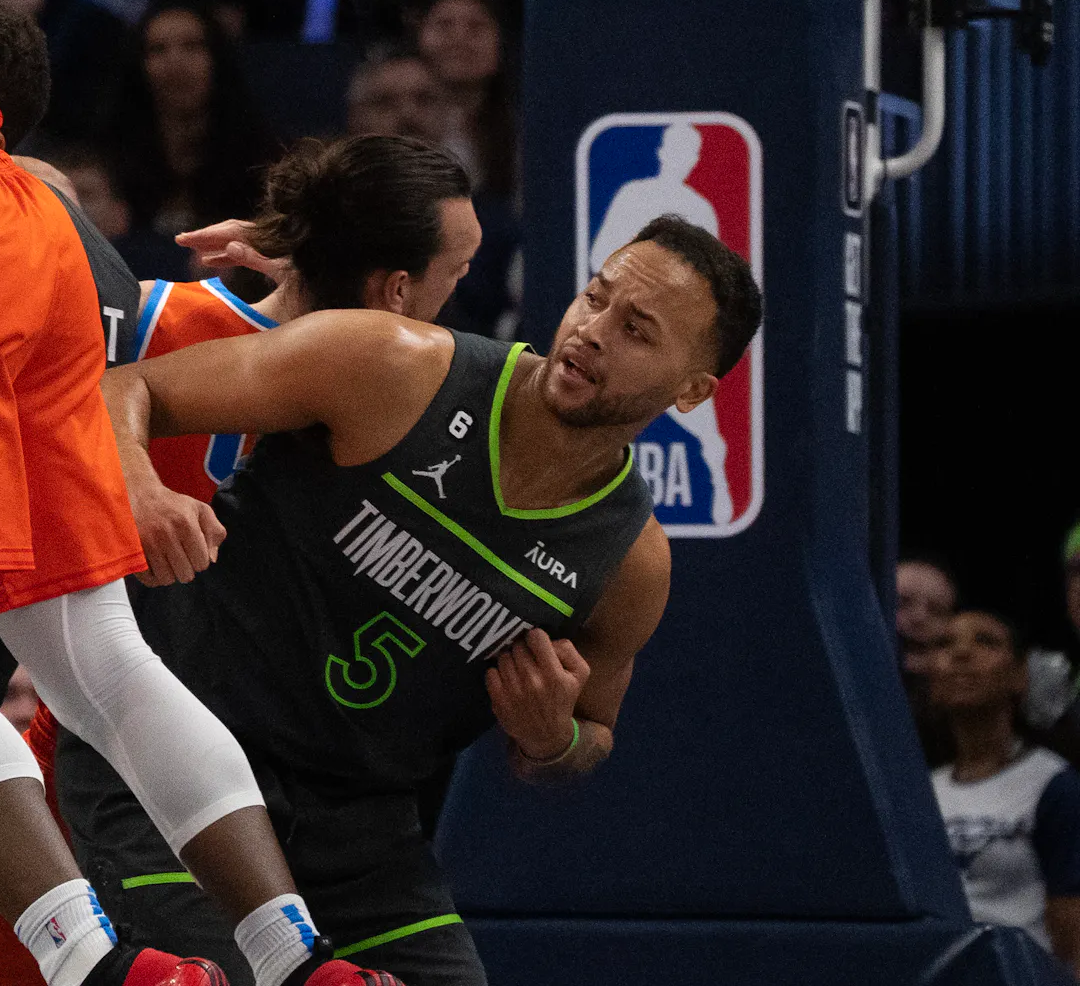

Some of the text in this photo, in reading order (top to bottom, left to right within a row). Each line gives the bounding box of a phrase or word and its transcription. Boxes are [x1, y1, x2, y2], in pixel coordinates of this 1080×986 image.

[448, 410, 474, 439] 6
[629, 441, 693, 507] BA
[332, 498, 535, 664] TIMBERWOLVE
[324, 611, 428, 710] 5
